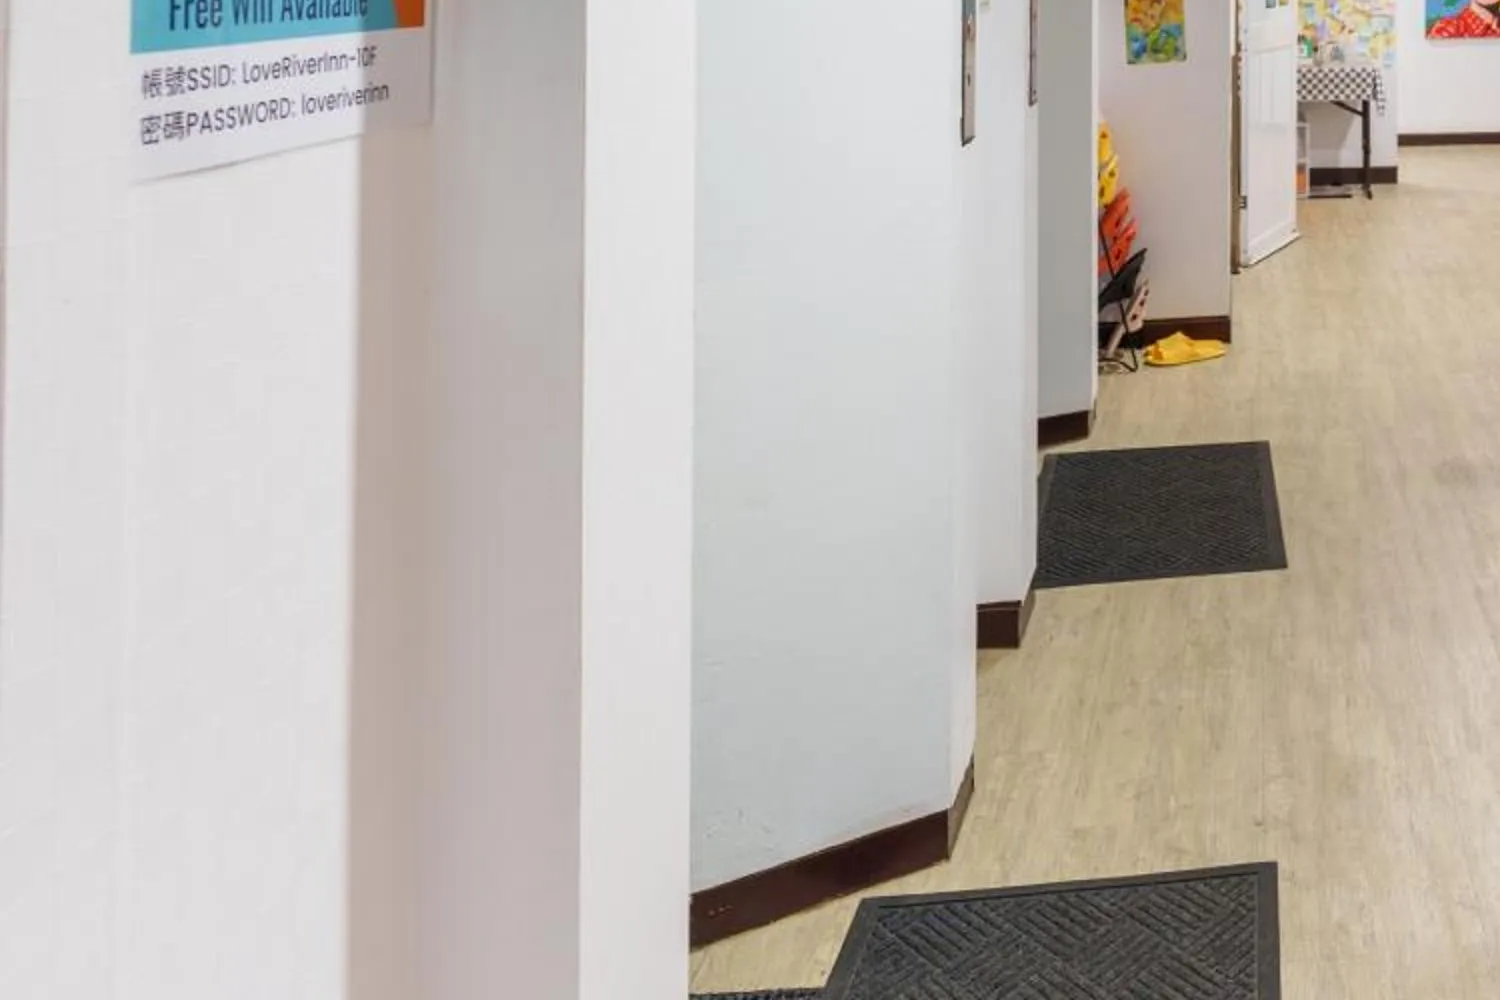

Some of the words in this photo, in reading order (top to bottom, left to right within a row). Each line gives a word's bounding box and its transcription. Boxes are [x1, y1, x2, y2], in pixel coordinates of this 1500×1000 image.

[140, 63, 237, 99] 帳號SSID:
[241, 45, 379, 85] LoveRiverInn-10F
[139, 97, 296, 146] 密碼PASSWORD:
[300, 82, 390, 117] loveriverinn
